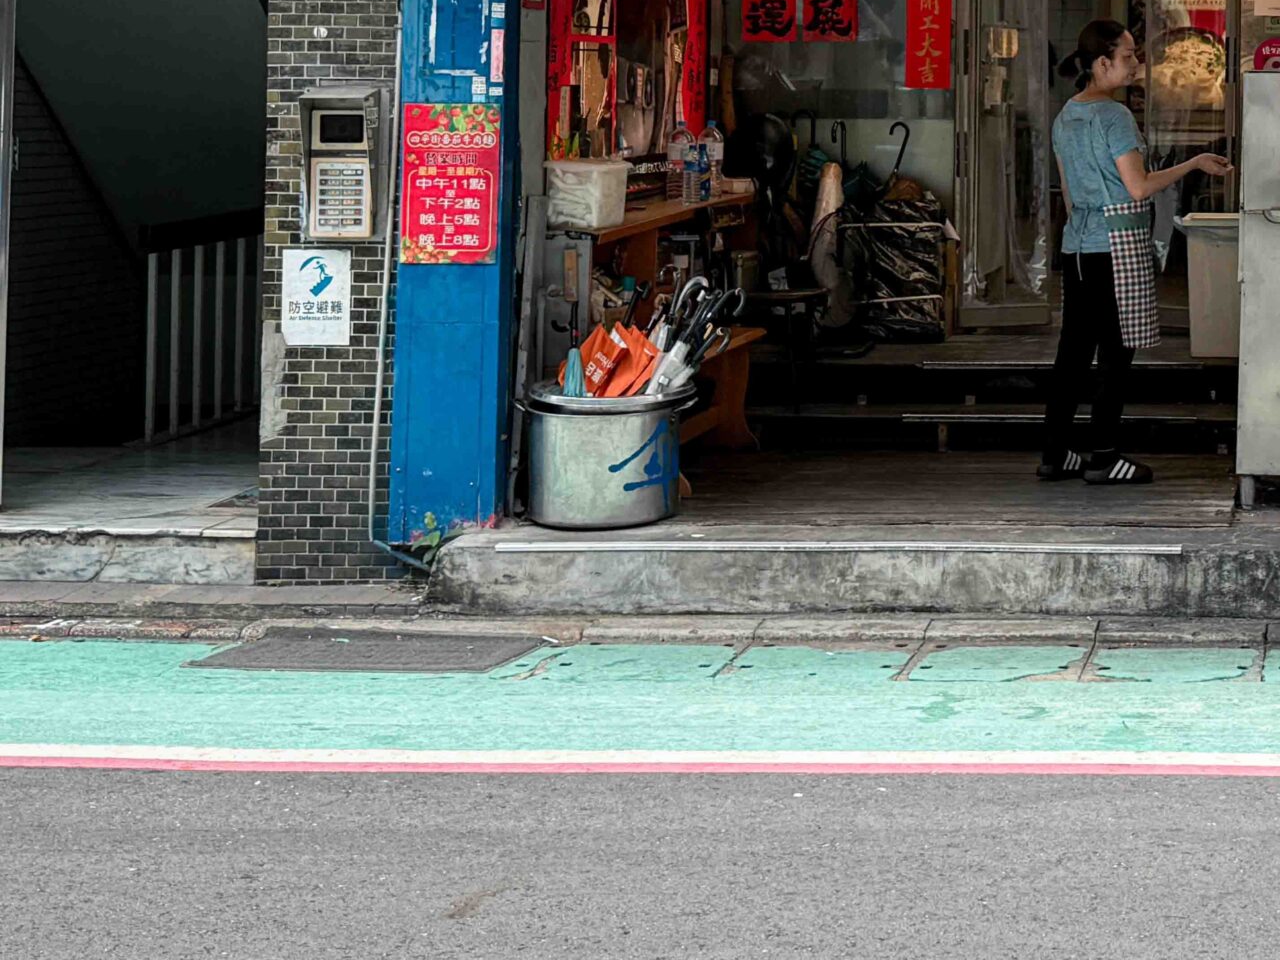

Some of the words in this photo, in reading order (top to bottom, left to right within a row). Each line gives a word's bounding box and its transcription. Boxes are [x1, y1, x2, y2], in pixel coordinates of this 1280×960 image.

[416, 178, 487, 190] 中午11點
[420, 197, 481, 210] 下午2點
[419, 213, 480, 226] 晚上5點
[418, 233, 480, 246] 晚上8點
[288, 300, 344, 314] 防空避難
